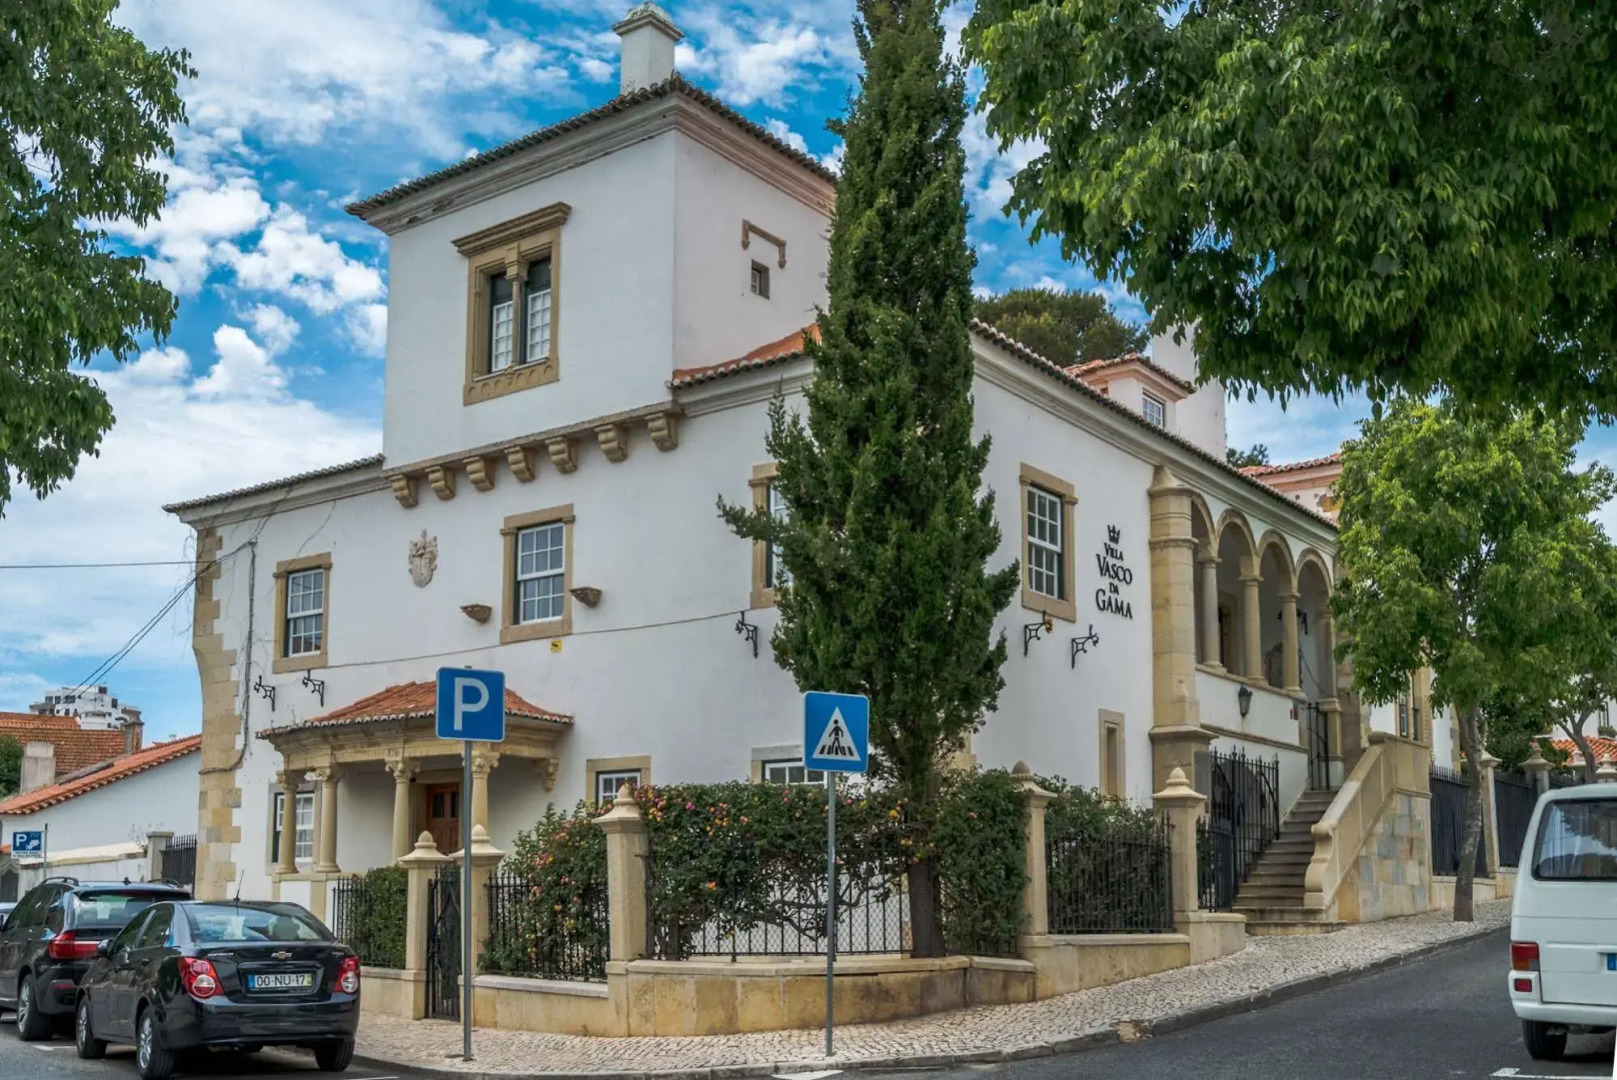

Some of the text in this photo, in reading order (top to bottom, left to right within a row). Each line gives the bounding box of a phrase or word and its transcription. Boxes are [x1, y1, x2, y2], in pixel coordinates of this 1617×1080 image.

[1096, 553, 1133, 585] VASCO
[1095, 588, 1133, 619] GAMA
[1109, 582, 1119, 595] DA
[454, 677, 489, 731] P
[16, 834, 27, 847] P
